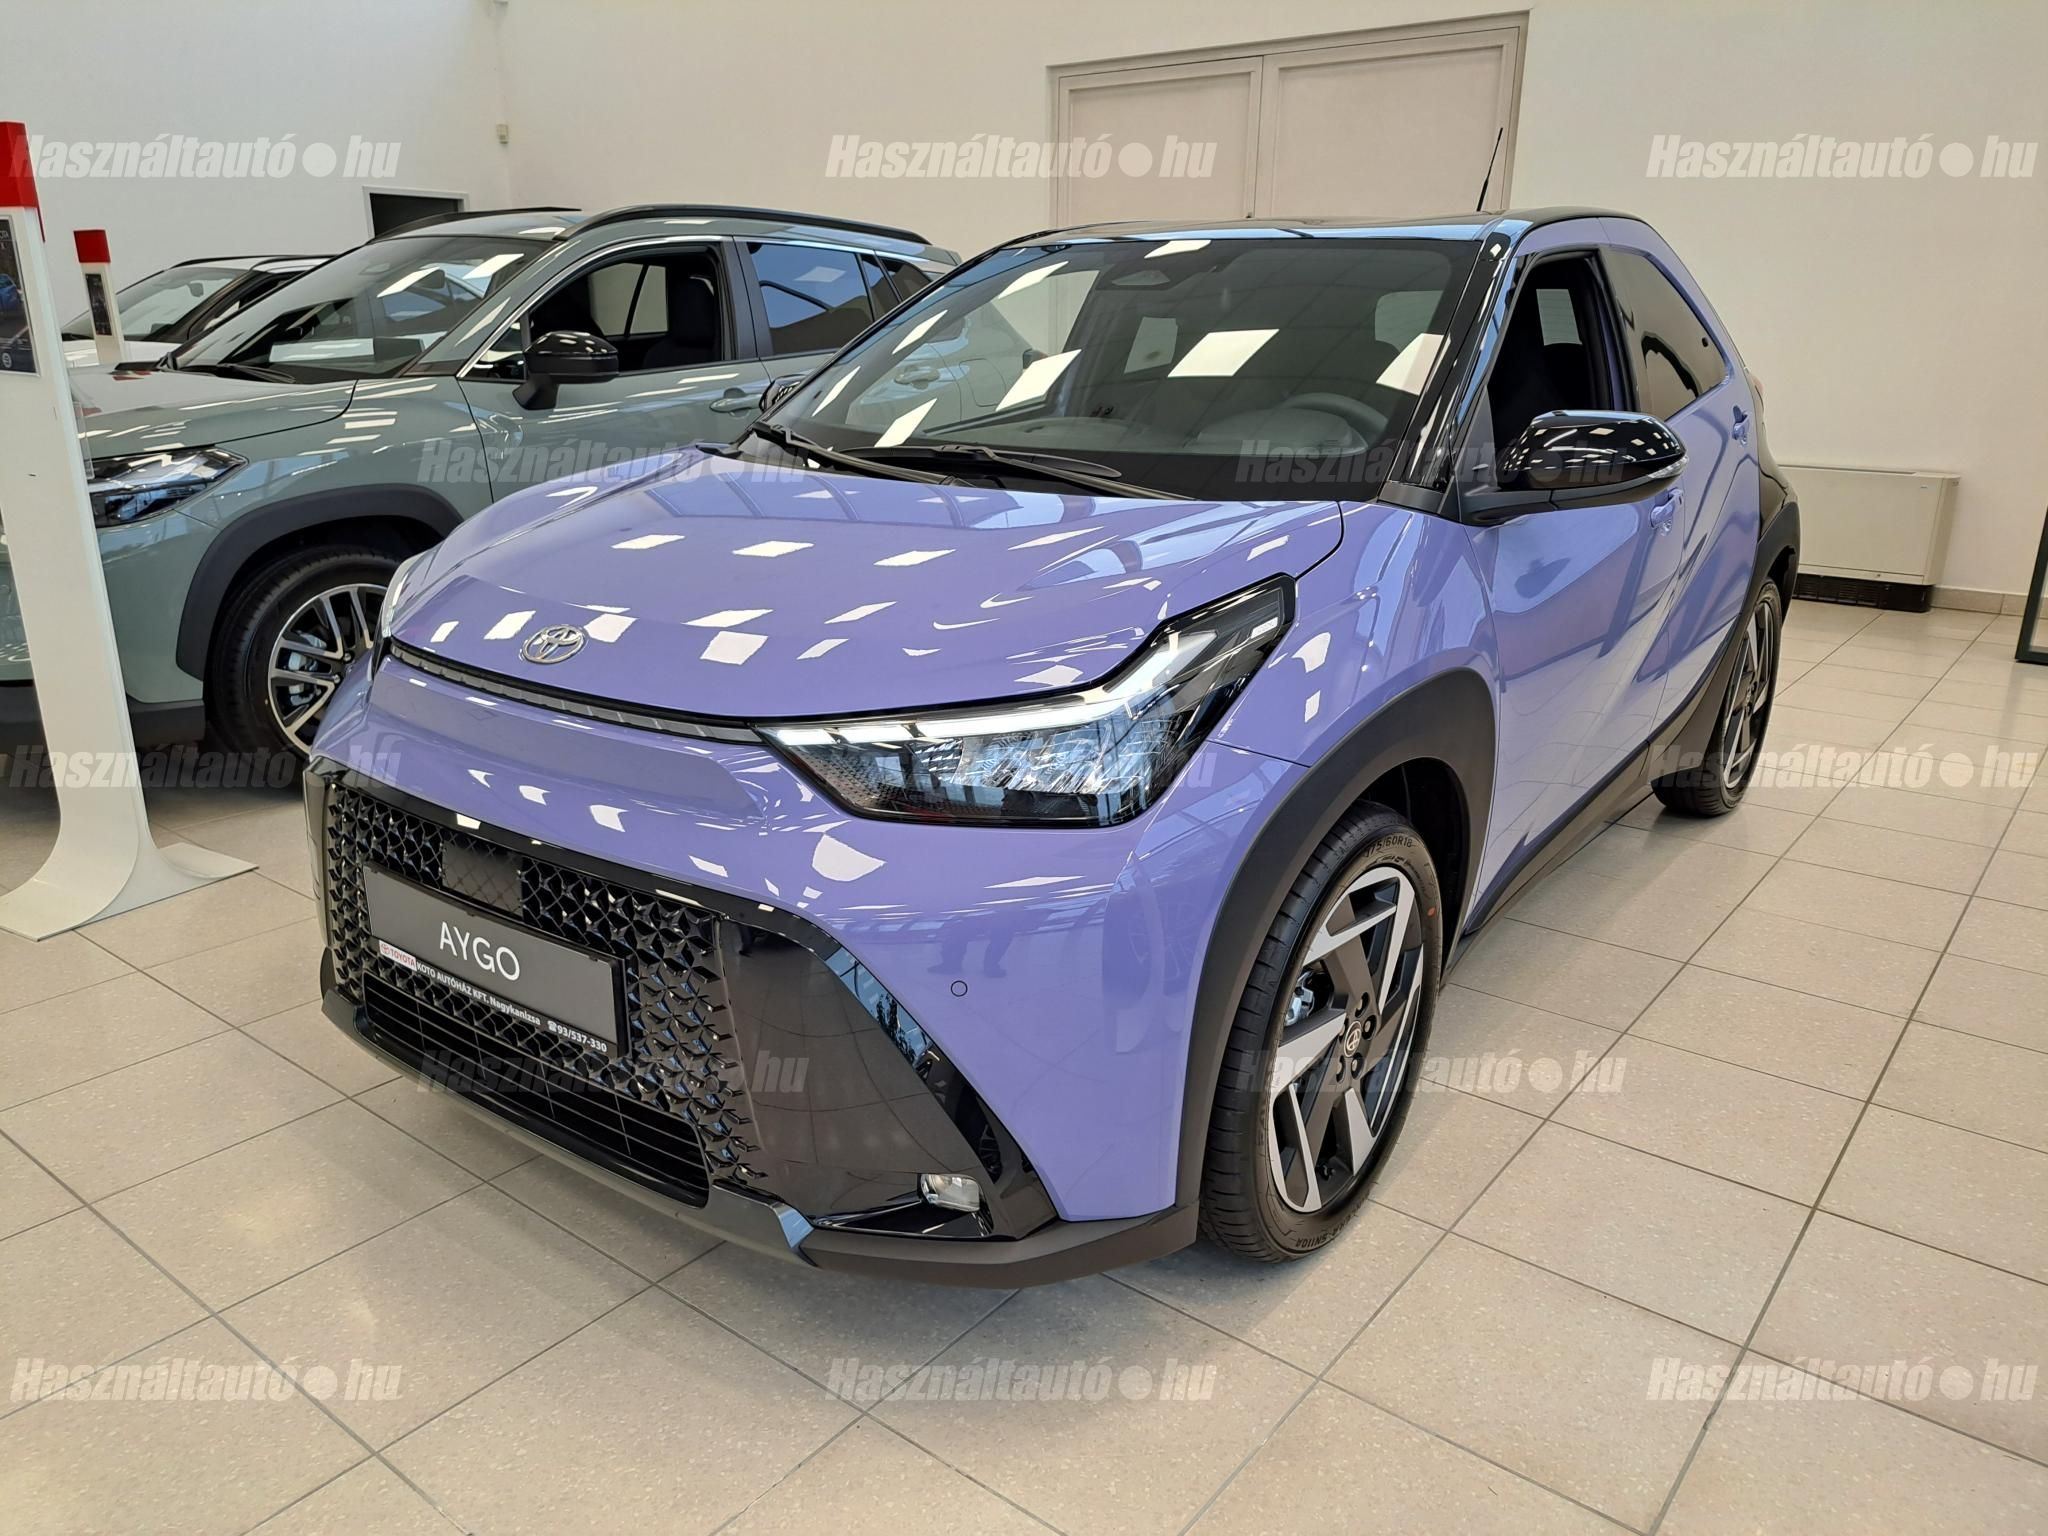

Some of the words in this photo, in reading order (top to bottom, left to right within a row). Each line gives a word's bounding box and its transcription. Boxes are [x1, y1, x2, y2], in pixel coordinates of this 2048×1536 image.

[439, 922, 520, 981] AYGO
[390, 948, 416, 968] TOYOTA
[416, 961, 436, 979] KOTO
[437, 972, 473, 996] AUTÓHÁZ
[489, 996, 541, 1026] Nagykanizsa
[557, 1025, 608, 1052] 93/537-330
